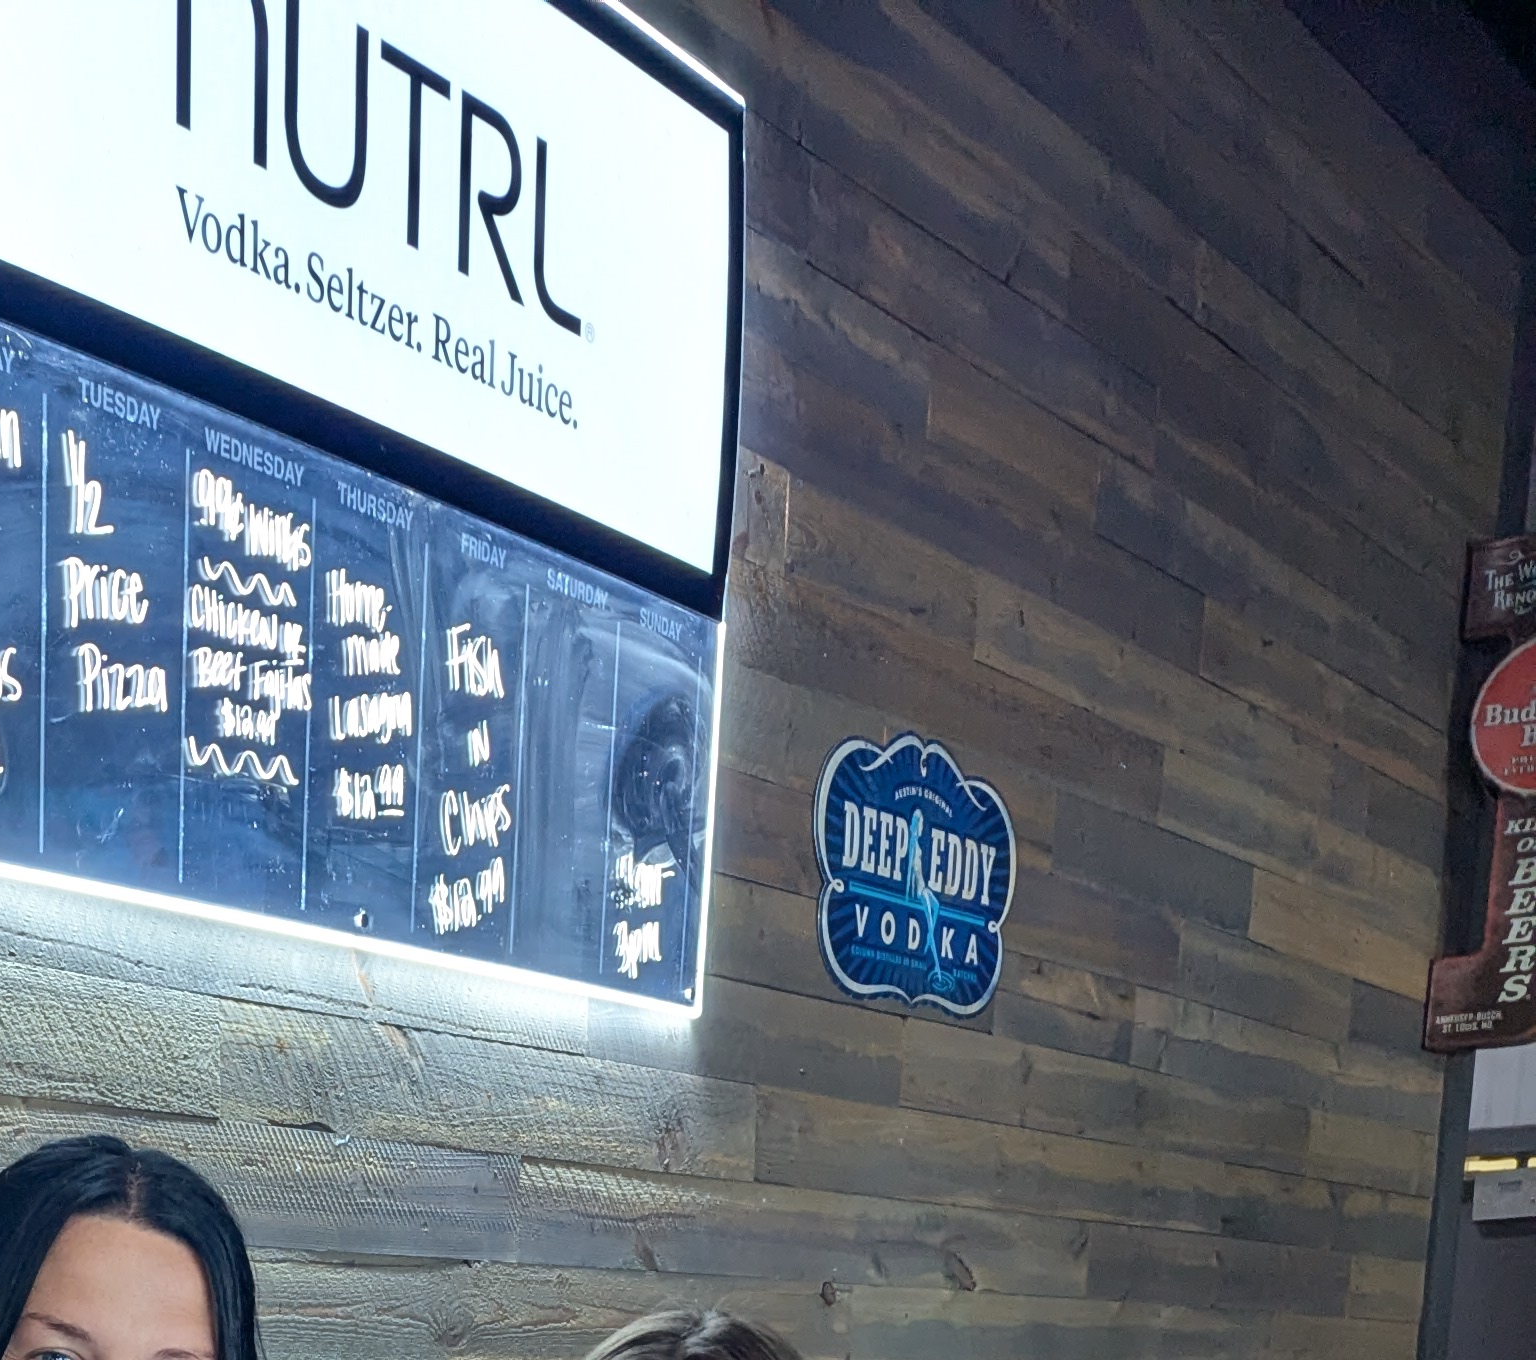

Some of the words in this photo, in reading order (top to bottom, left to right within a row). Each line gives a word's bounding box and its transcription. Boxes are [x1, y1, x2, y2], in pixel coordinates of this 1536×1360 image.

[431, 311, 497, 391] Real
[499, 338, 579, 430] Juice.
[78, 376, 160, 430] TUESDAY
[205, 427, 304, 486] WEDNESDAY
[337, 481, 413, 531] THURSDAY
[460, 533, 506, 569] FRIDAY
[61, 556, 148, 627] Price
[547, 568, 608, 609] SATURDAY
[640, 607, 682, 642] SUNDAY
[74, 643, 167, 712] Pizza
[446, 623, 504, 698] Fish
[441, 784, 511, 856] Chips
[842, 800, 909, 881] DEEP
[927, 827, 996, 906] EDDY
[855, 903, 979, 966] VODKA
